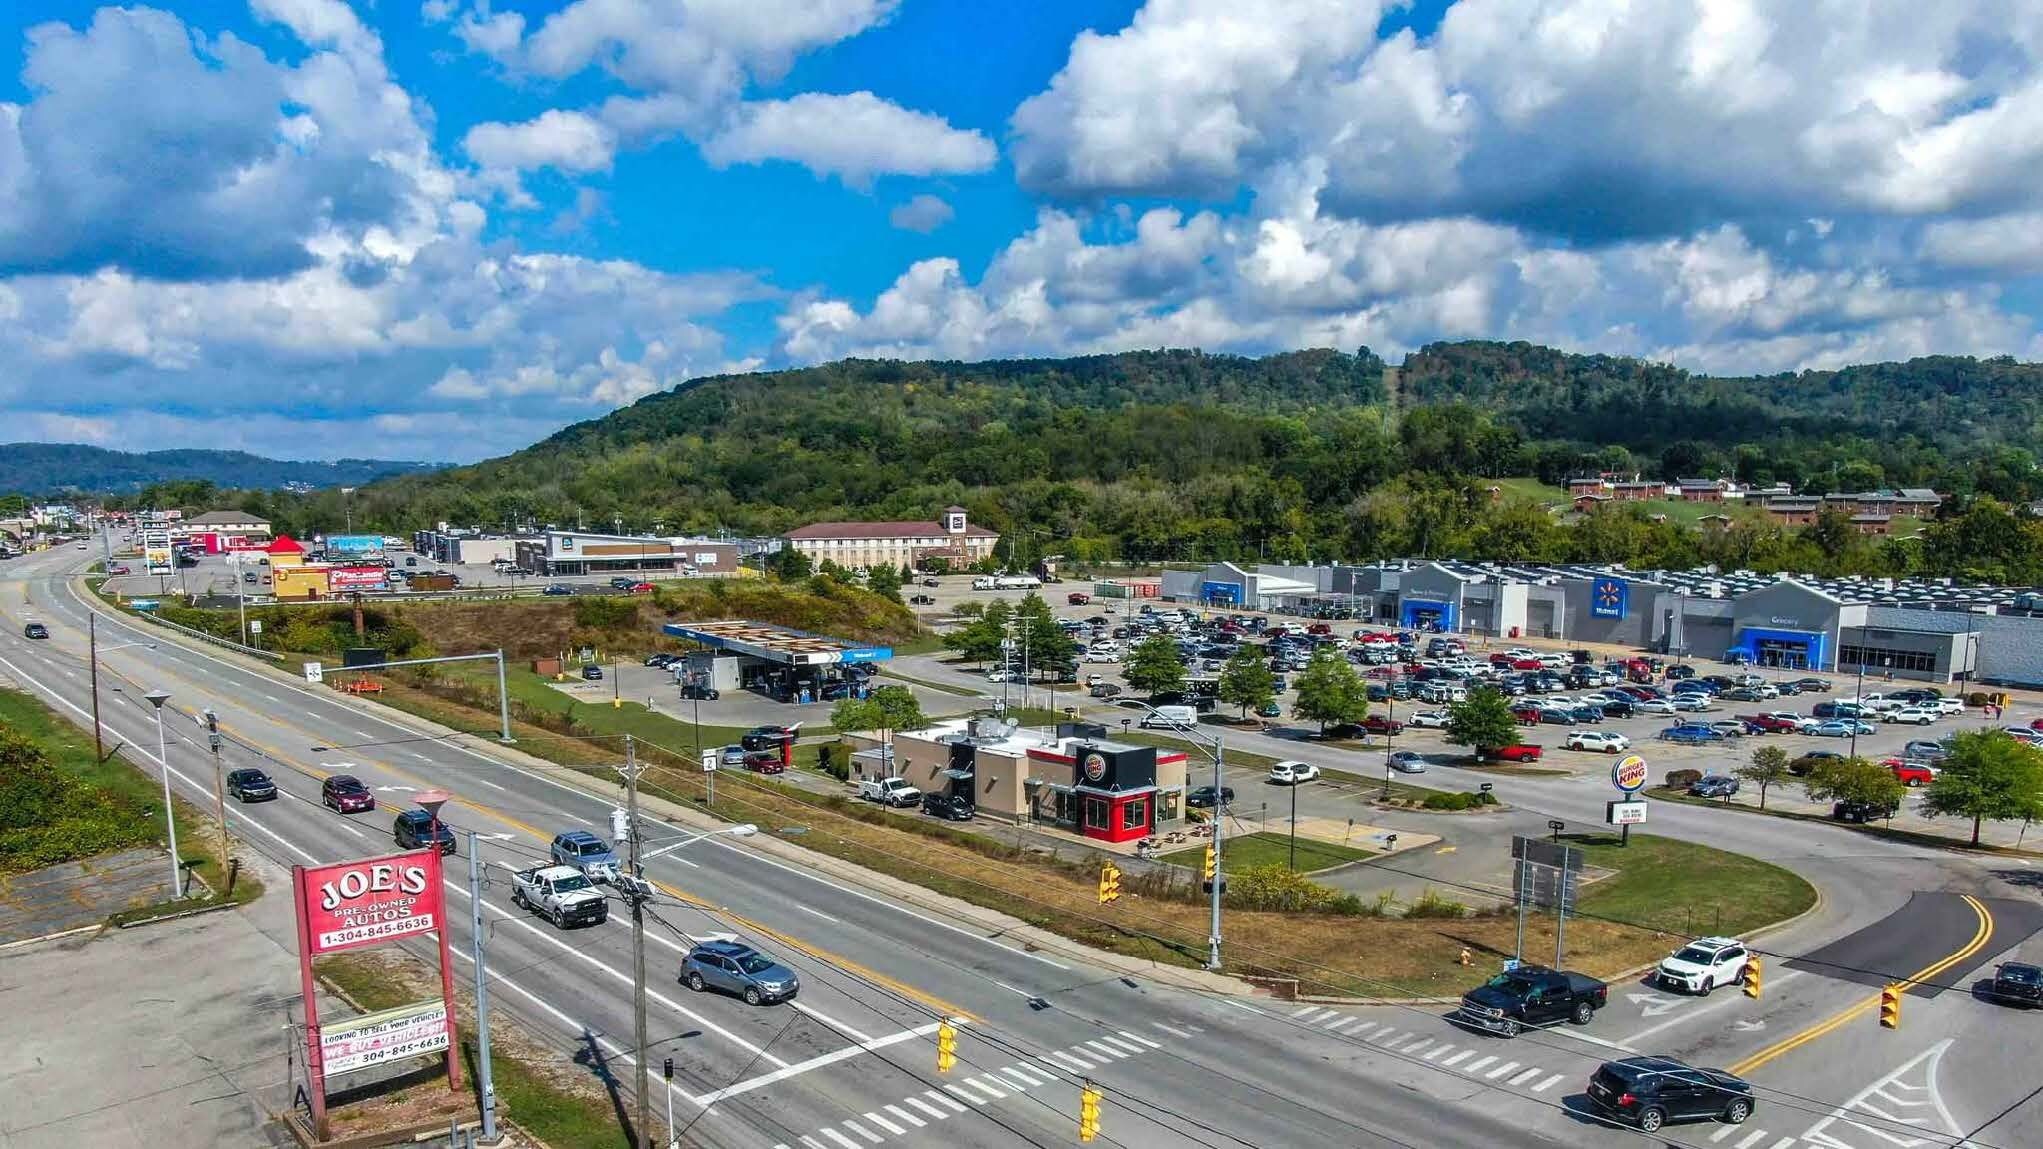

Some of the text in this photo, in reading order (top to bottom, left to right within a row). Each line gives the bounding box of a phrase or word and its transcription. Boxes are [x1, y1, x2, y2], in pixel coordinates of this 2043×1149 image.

[1619, 761, 1644, 775] BURGER
[1619, 768, 1645, 784] KING
[320, 863, 426, 911] JOE'S
[343, 907, 412, 928] AUTOS
[324, 917, 429, 944] 1-304-845-6636
[325, 1031, 357, 1044] LOOKING
[360, 1027, 369, 1037] TO
[371, 1025, 387, 1035] SELL
[390, 1019, 409, 1030] YOUR
[362, 1035, 447, 1063] 304-845-6636
